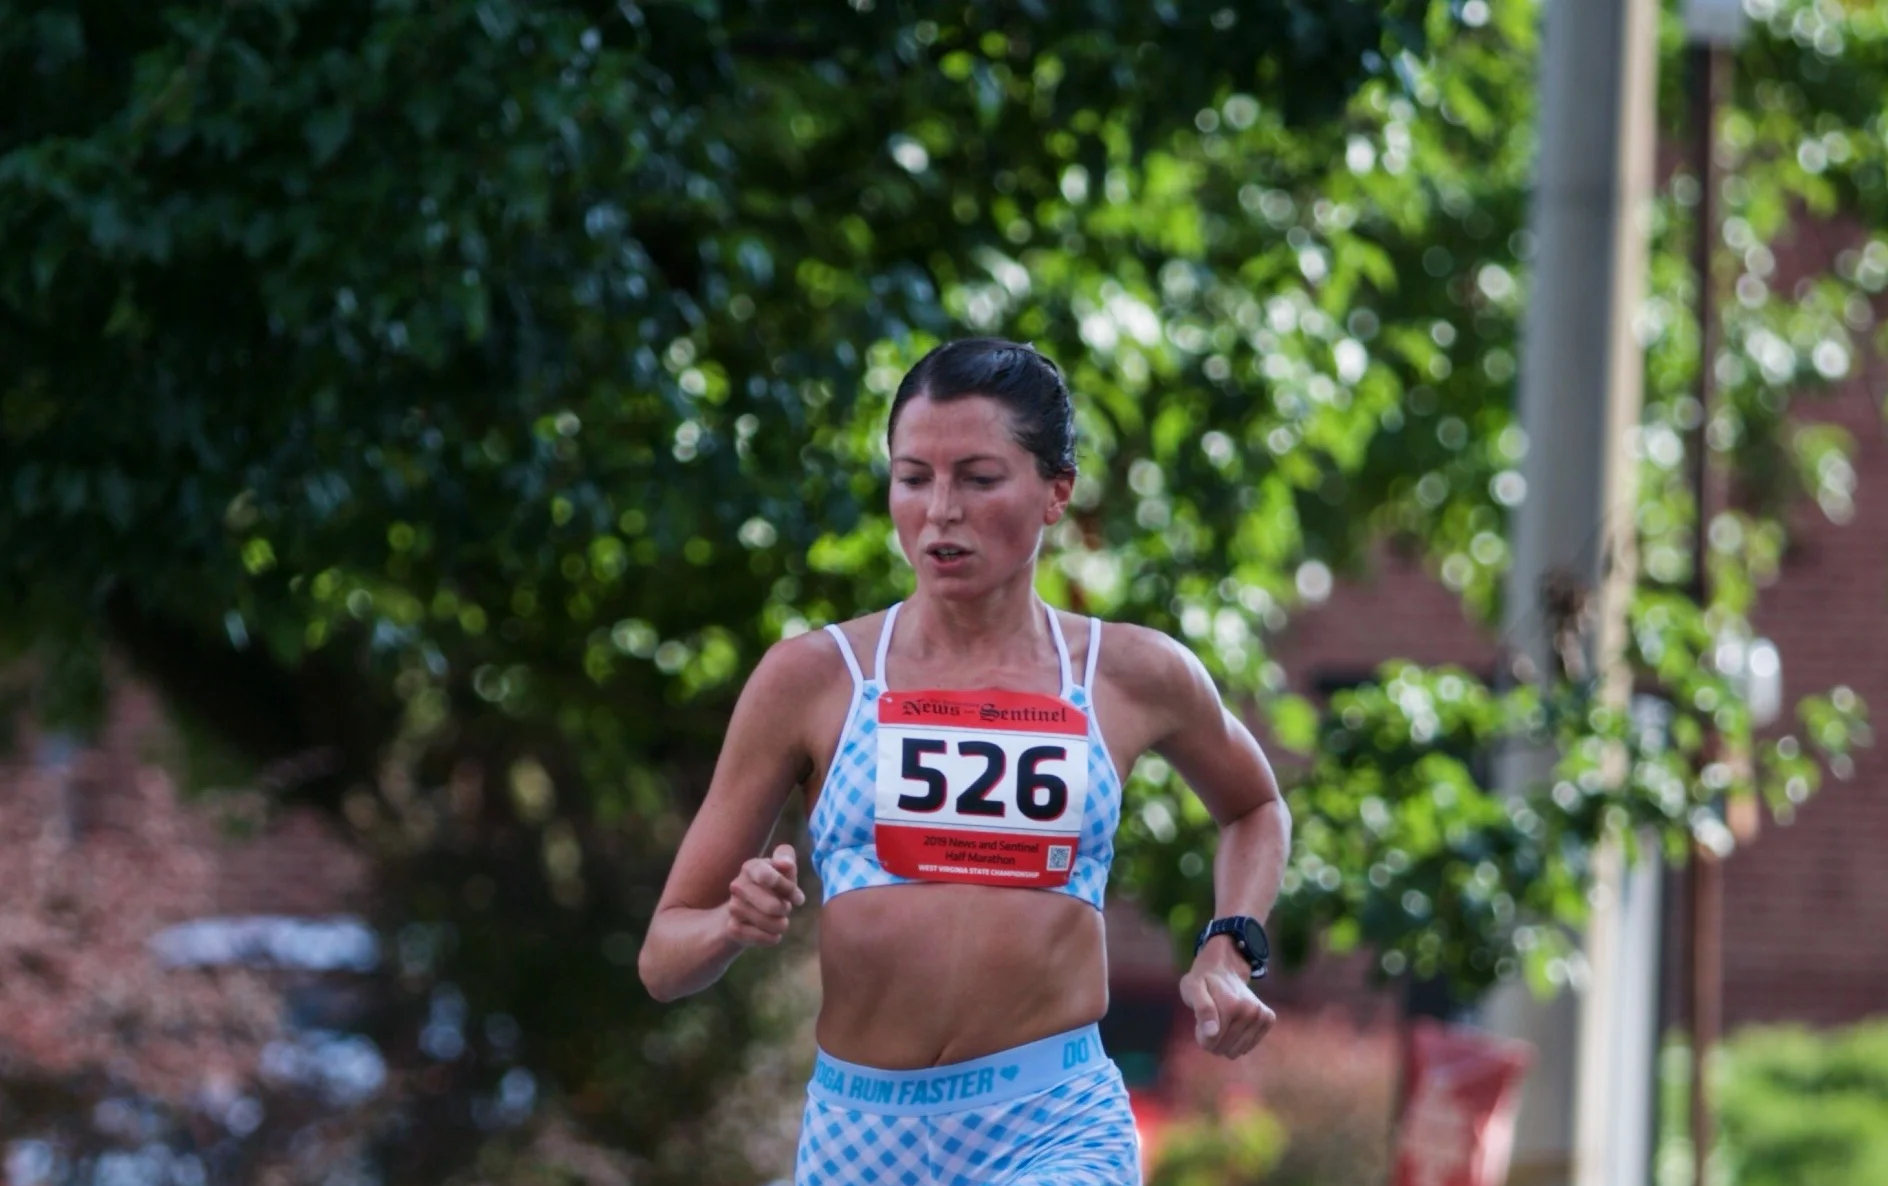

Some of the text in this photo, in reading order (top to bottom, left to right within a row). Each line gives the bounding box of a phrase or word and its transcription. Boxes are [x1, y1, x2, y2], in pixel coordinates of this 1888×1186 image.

[902, 700, 961, 716] News
[979, 703, 1067, 722] Sentinel
[897, 737, 1068, 822] 526
[923, 835, 1039, 853] 2019 News and Sentinel
[945, 850, 1017, 865] Half Marathon
[918, 864, 1040, 879] WEST VIRGINIA STATE CHAMPIONSHIP
[1063, 1035, 1090, 1071] DO
[848, 1074, 895, 1105] RUN
[897, 1066, 995, 1105] FASTER
